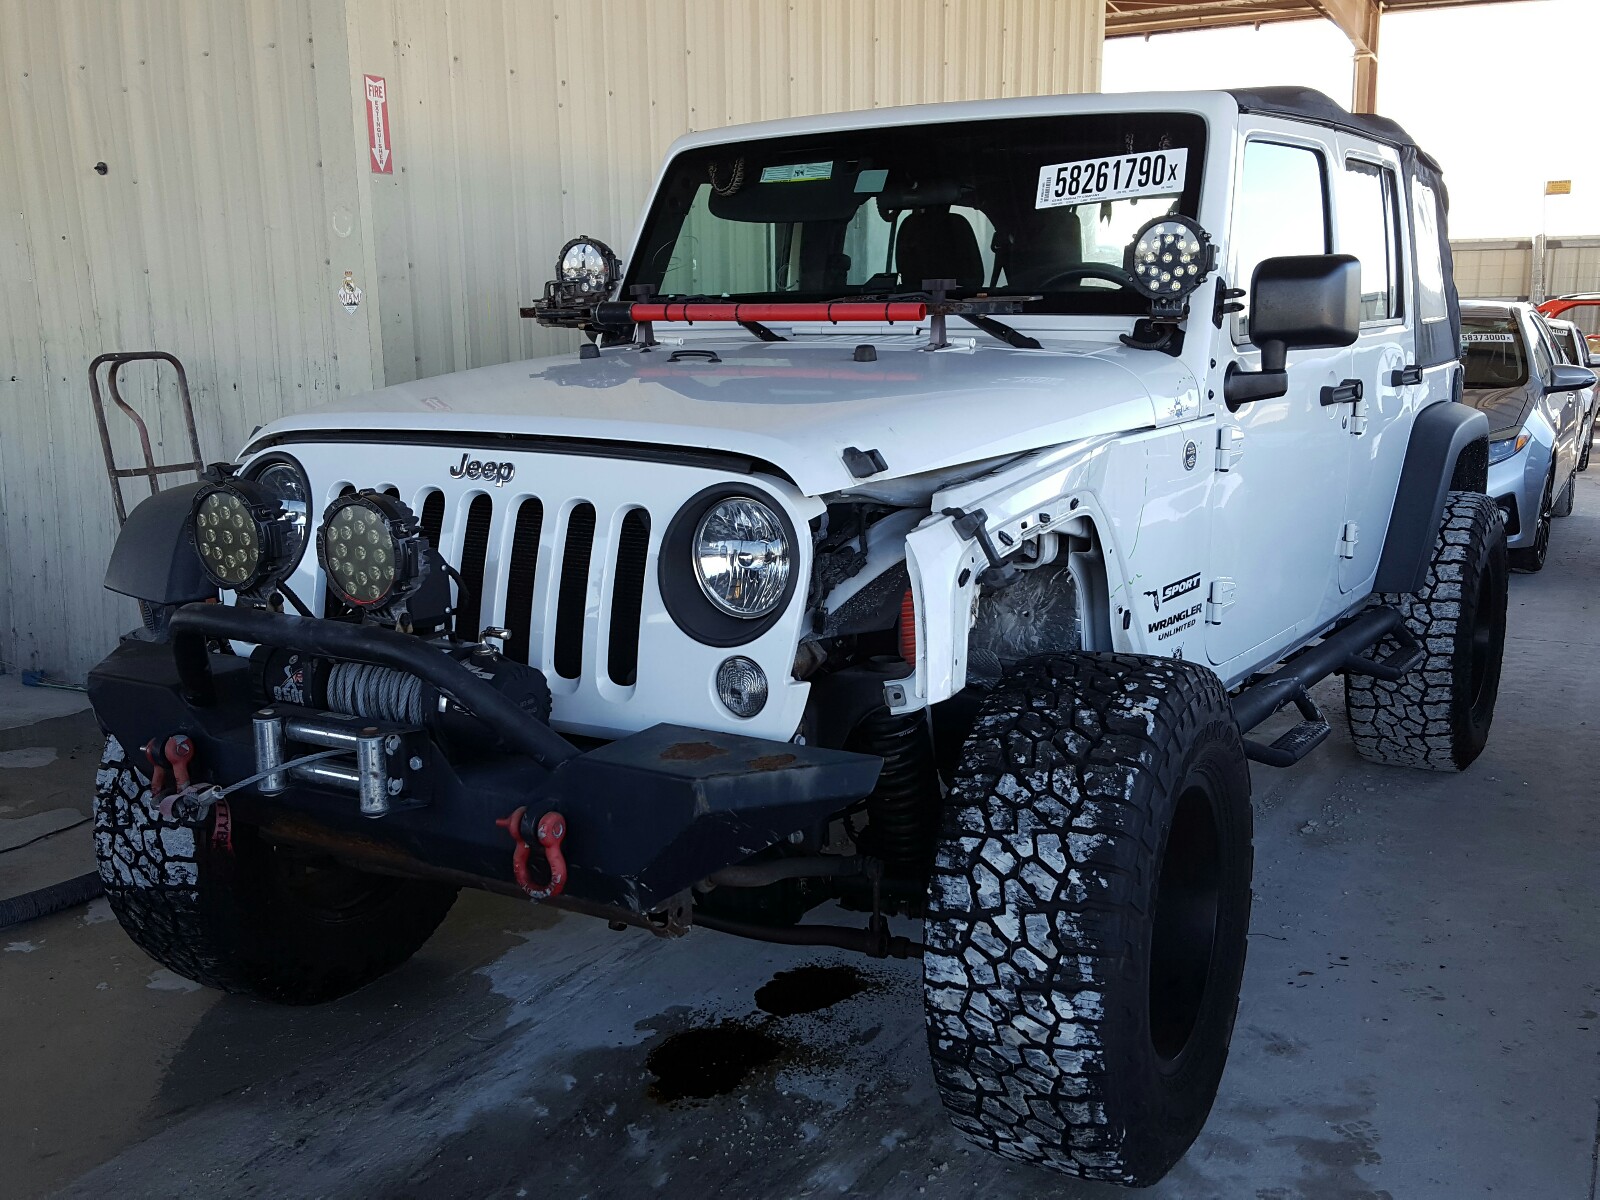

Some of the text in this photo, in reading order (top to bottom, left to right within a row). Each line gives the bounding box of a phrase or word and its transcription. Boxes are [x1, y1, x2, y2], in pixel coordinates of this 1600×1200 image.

[368, 84, 383, 98] FIRE
[374, 100, 384, 164] EXTINGUISHER
[450, 453, 515, 488] Jeep
[1164, 575, 1200, 597] SPORT
[1148, 603, 1202, 634] WRANGLER
[1158, 619, 1196, 641] UNLIMITED
